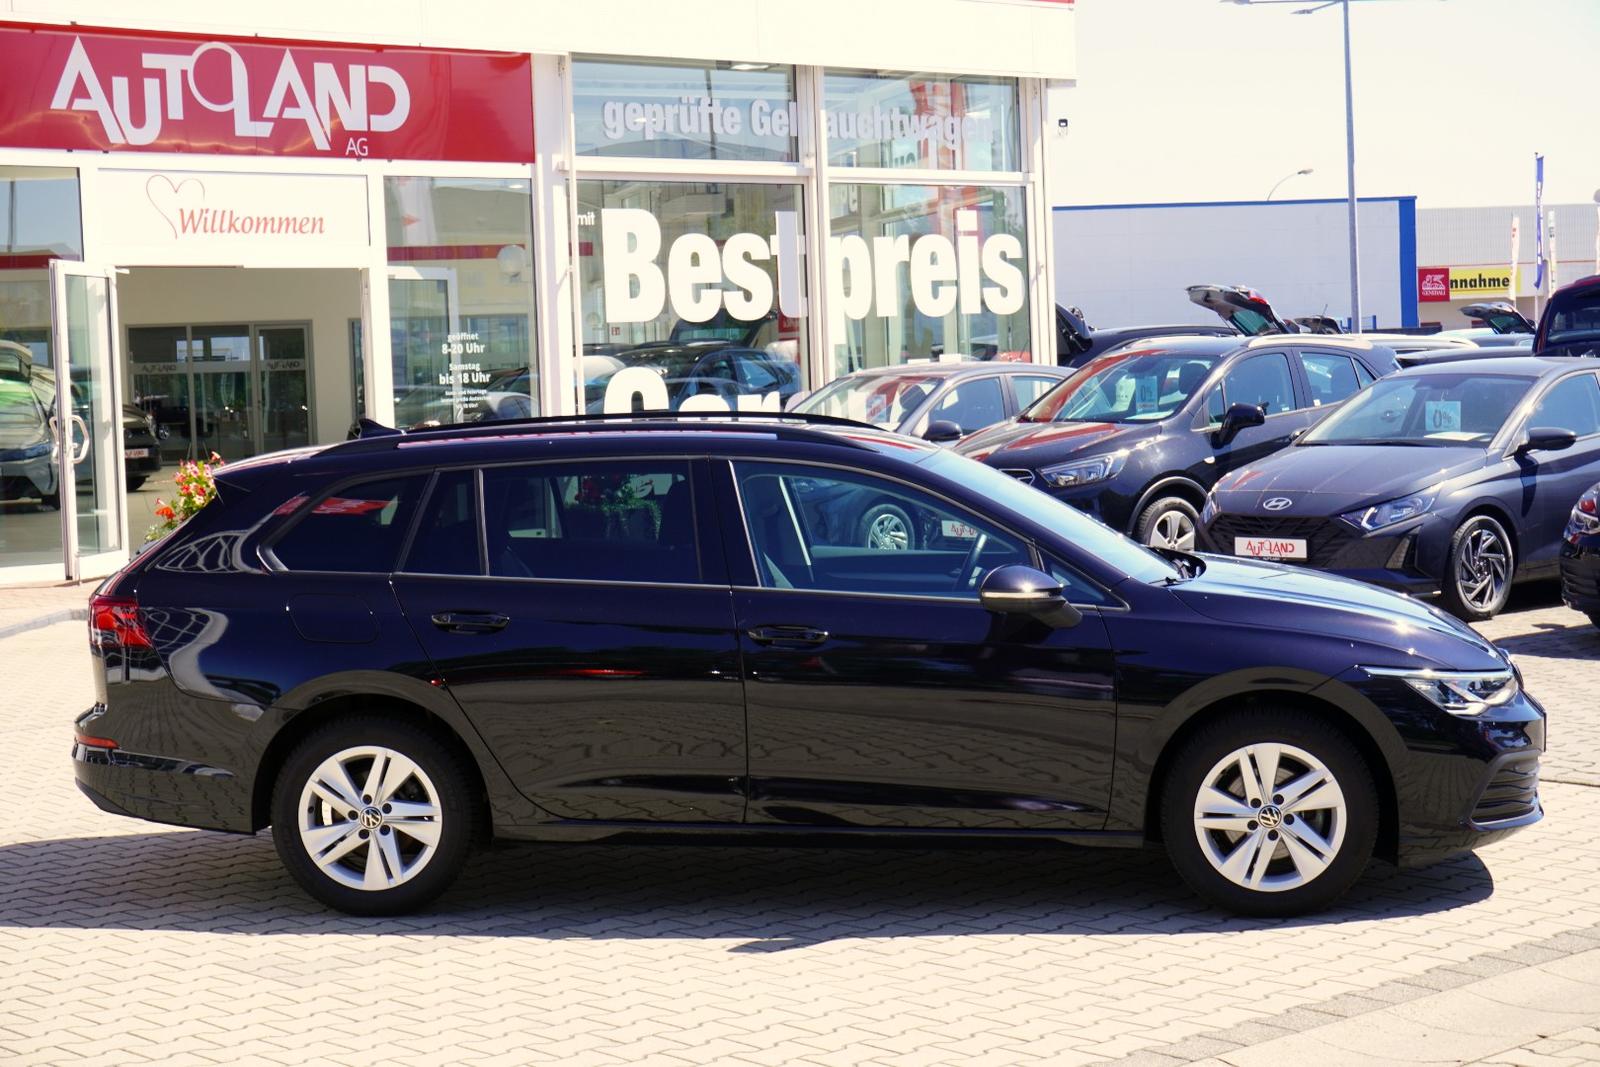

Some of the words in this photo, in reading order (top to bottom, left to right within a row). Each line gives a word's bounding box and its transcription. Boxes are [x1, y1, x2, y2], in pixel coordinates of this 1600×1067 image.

[603, 96, 741, 140] geprüfte
[345, 137, 369, 157] AG
[179, 207, 326, 235] Willkommen
[447, 332, 480, 343] geöffnet
[441, 343, 464, 354] 8-20
[465, 342, 486, 354] Uhr
[449, 363, 481, 371] Samstag
[439, 373, 455, 385] bis
[457, 372, 470, 384] 18
[471, 371, 492, 384] Uhr
